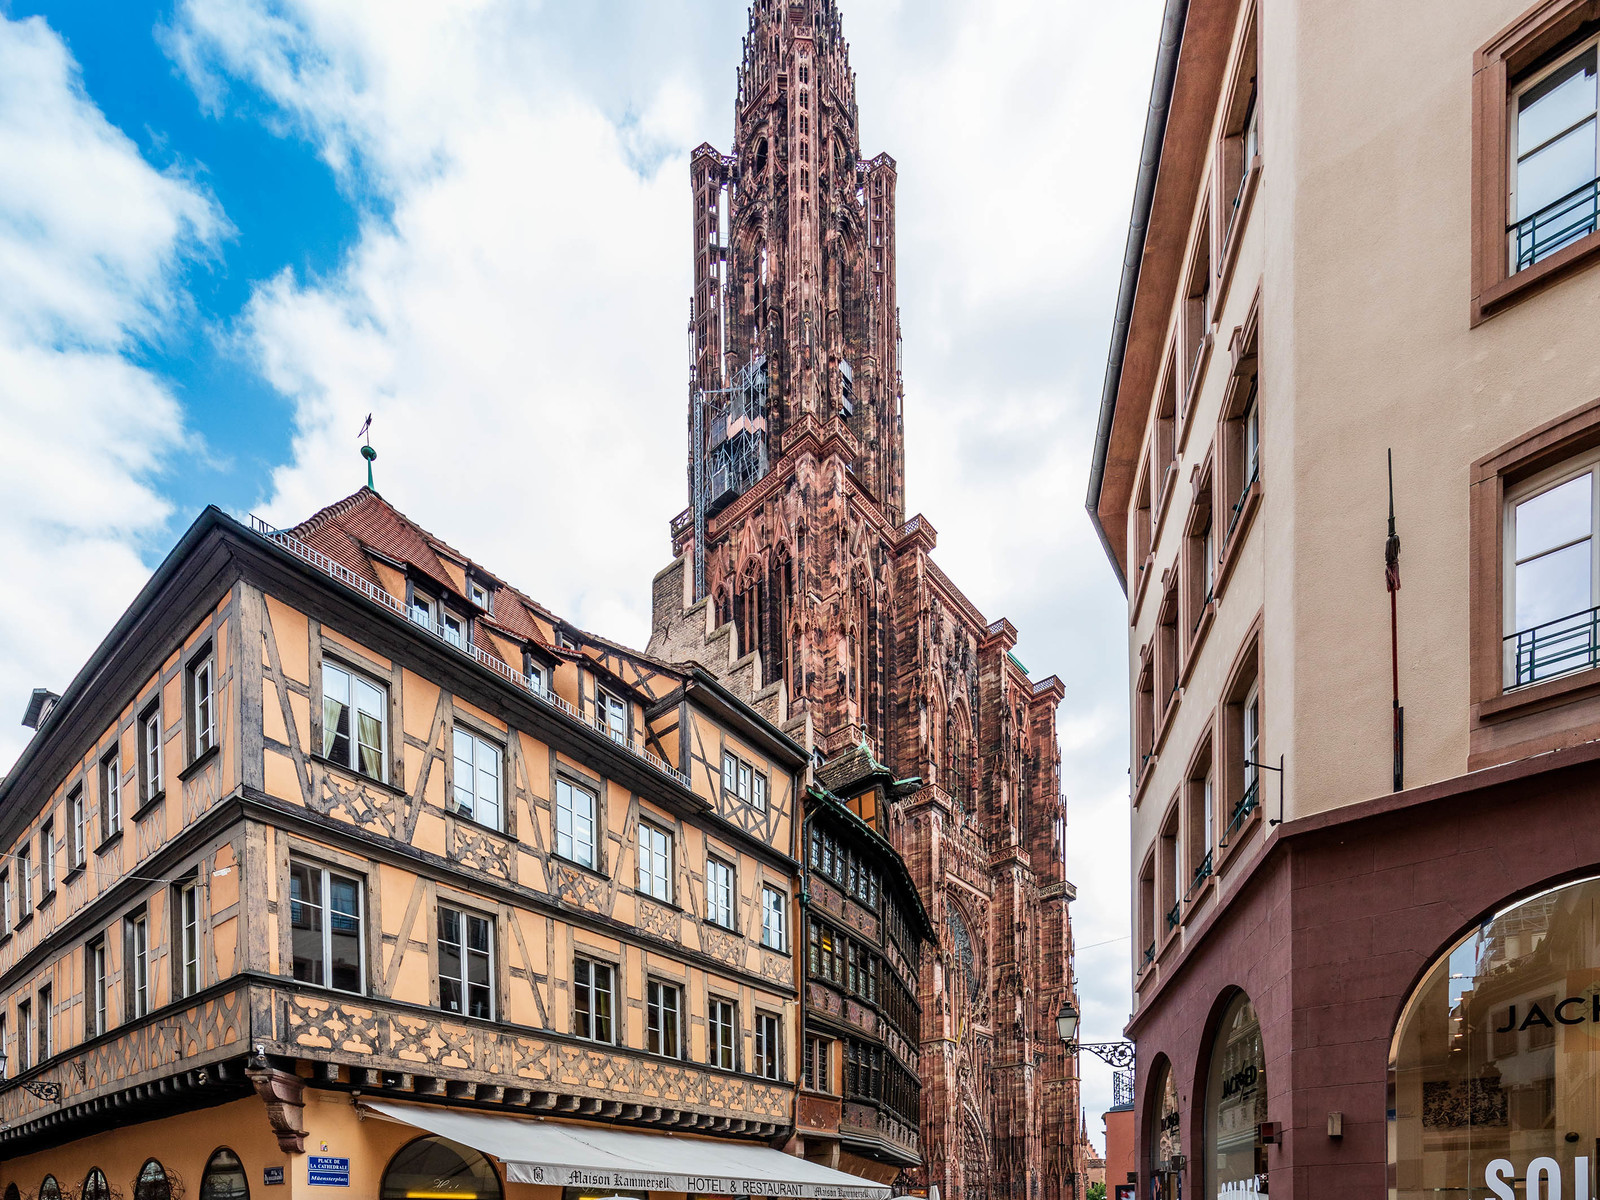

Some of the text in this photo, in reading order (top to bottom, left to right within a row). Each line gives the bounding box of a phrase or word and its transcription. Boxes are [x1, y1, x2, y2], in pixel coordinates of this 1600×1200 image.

[568, 1170, 610, 1186] Maison
[613, 1173, 670, 1189] Kammerzell
[687, 1177, 725, 1193] HOTEL
[729, 1180, 738, 1193] &
[742, 1180, 803, 1197] RESTAURANT
[814, 1186, 837, 1197] Maison
